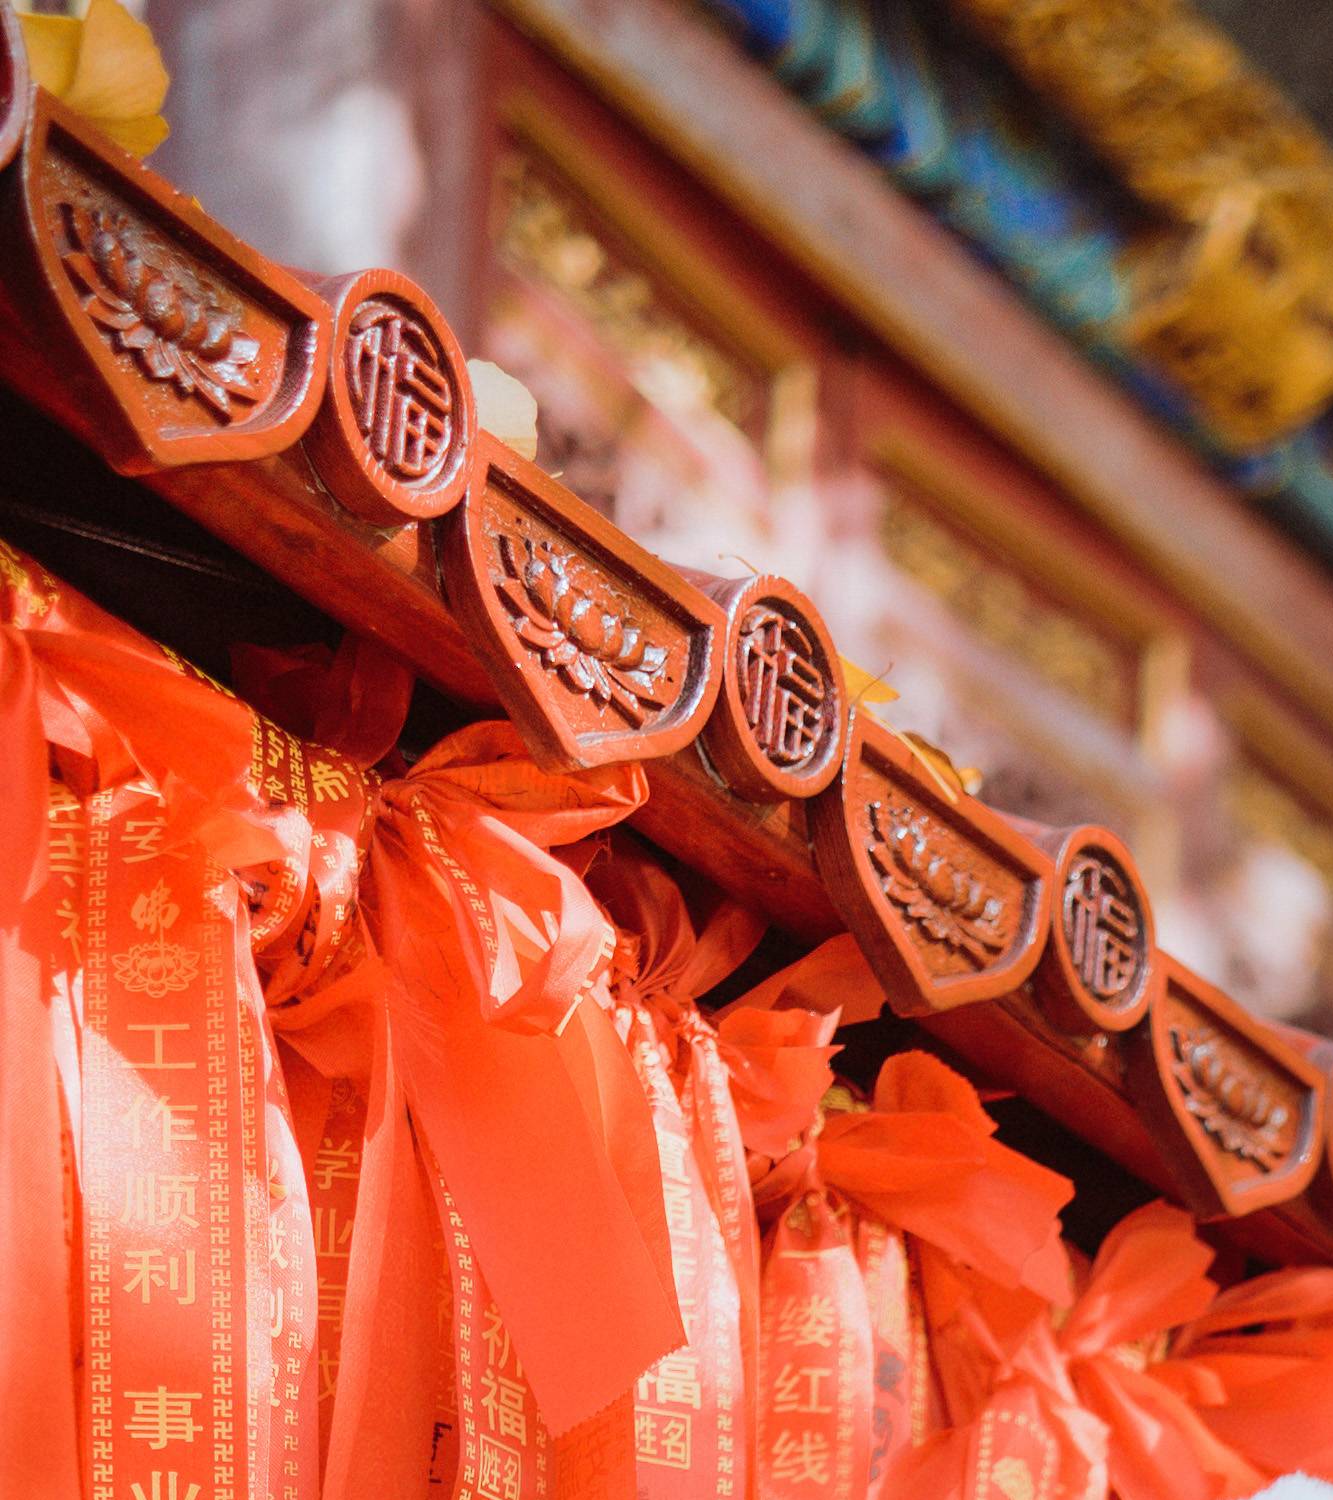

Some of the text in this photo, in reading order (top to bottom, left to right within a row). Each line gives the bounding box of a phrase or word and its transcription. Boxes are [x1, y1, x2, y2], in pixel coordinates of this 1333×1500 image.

[120, 1022, 200, 1310] 工作顺利
[771, 1248, 849, 1486] 一缕红线
